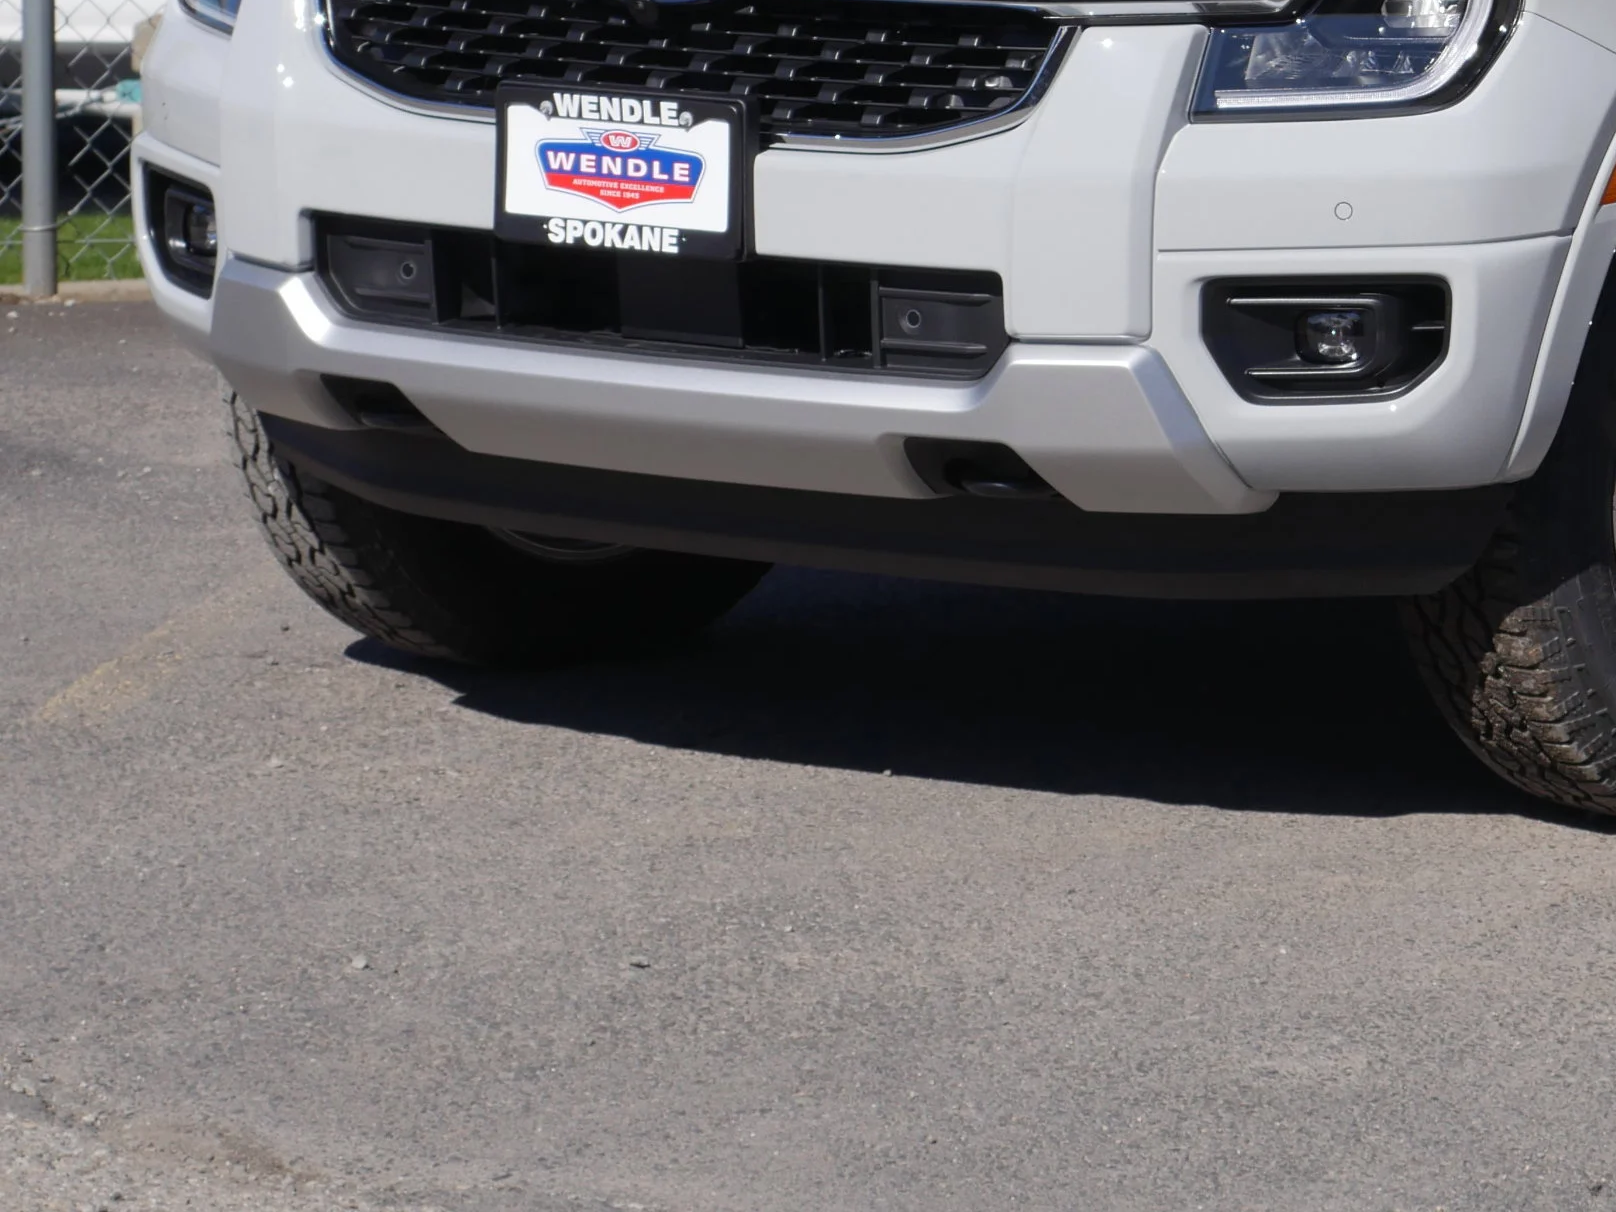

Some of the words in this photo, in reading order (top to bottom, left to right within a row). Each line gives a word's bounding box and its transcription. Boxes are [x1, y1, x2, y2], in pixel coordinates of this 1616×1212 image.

[552, 92, 679, 127] WENDLE
[547, 150, 690, 182] WENDLE
[572, 178, 618, 189] AUTOMOTIVE
[619, 182, 665, 193] EXCELLENCE
[600, 189, 621, 198] SINCE
[547, 218, 680, 254] SPOKANE
